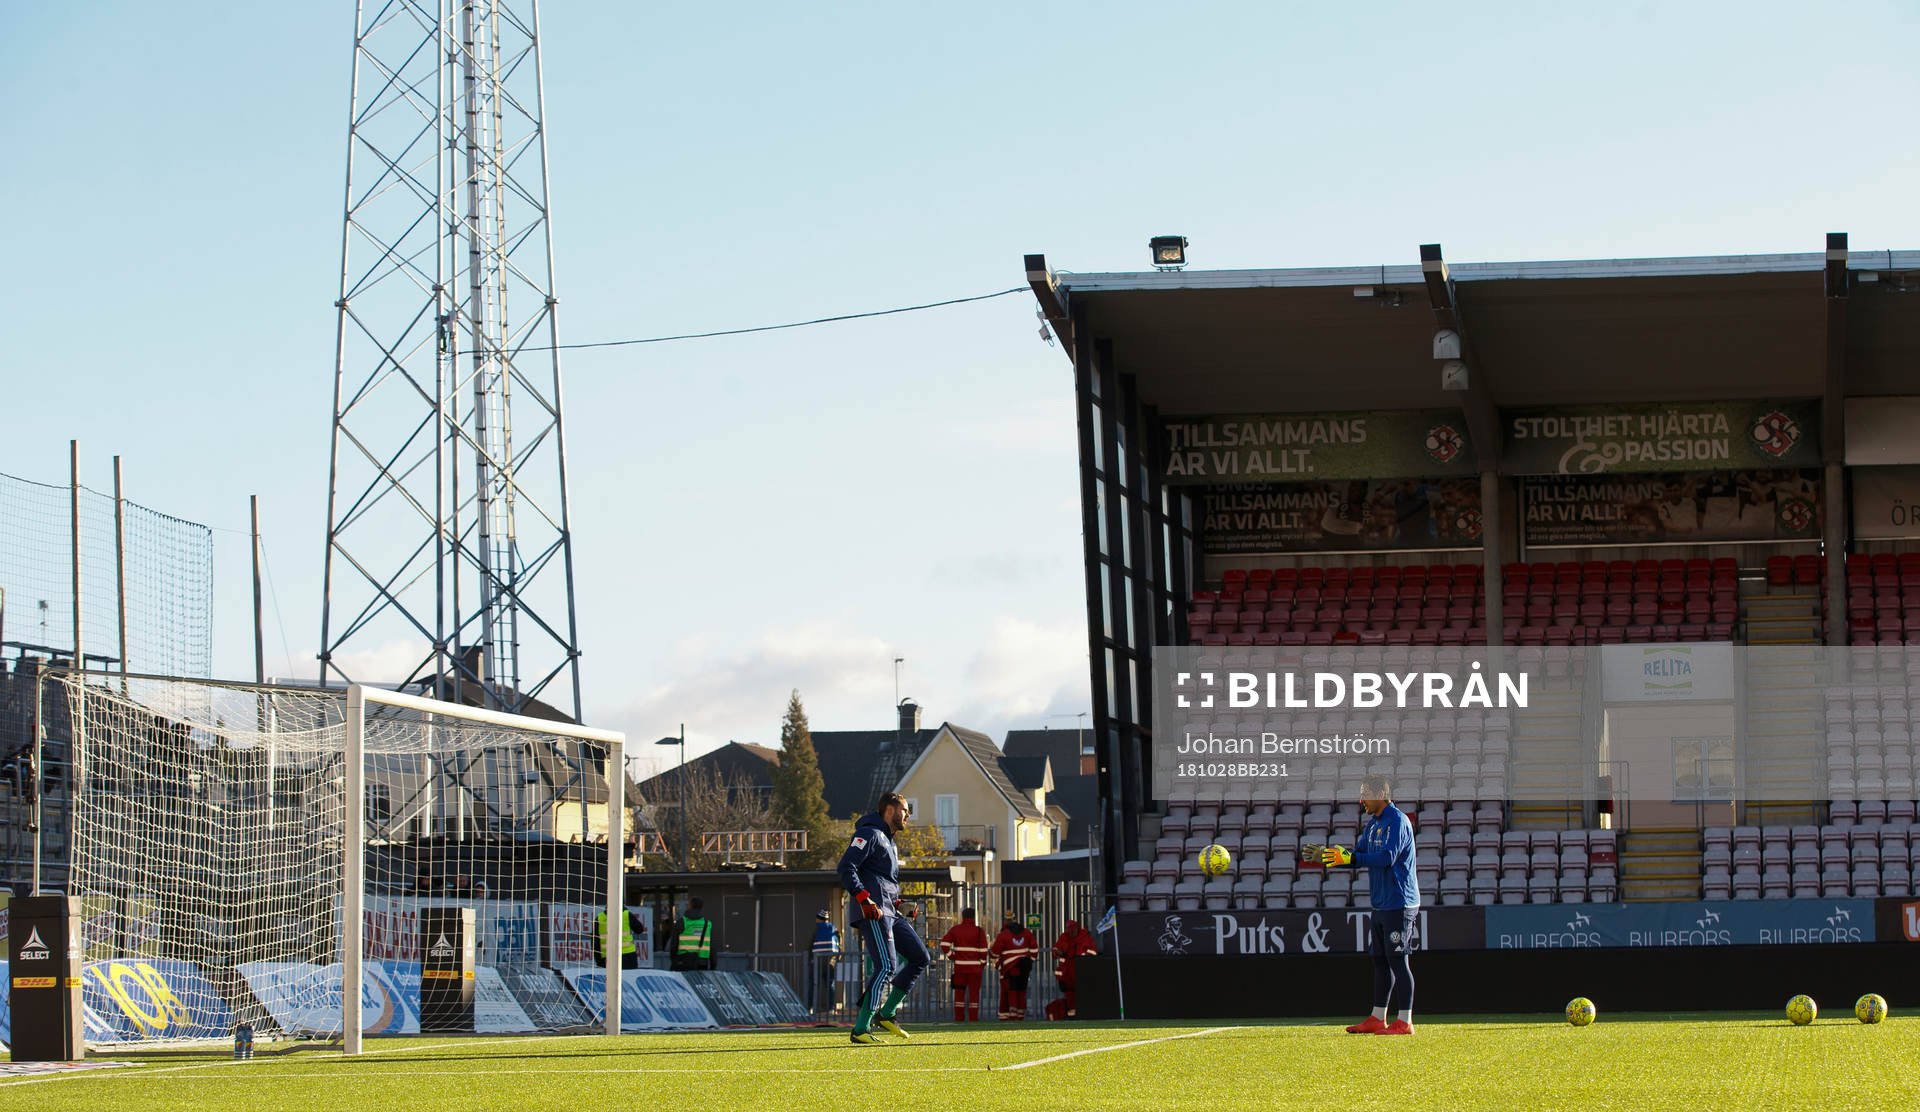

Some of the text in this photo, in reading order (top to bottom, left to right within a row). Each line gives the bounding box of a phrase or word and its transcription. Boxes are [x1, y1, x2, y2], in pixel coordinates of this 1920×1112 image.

[1165, 418, 1368, 448] TILLSAMMANS
[1513, 410, 1730, 440] STOLTHET, HJÄRTA
[1624, 438, 1730, 463] PASSION
[1166, 447, 1315, 476] ÄR VI ALLT.
[1202, 491, 1340, 512] TILLSAMMANS
[1525, 482, 1664, 503] TILLSAMMANS
[1204, 511, 1304, 530] ÄR VI ALLT.
[1526, 502, 1628, 522] ÄR VI ALLT.
[1643, 658, 1692, 677] RELITA
[1211, 914, 1285, 955] Puts
[1301, 911, 1331, 953] &
[19, 950, 51, 960] SELECT
[430, 949, 454, 957] SELECT
[18, 978, 52, 986] DHL
